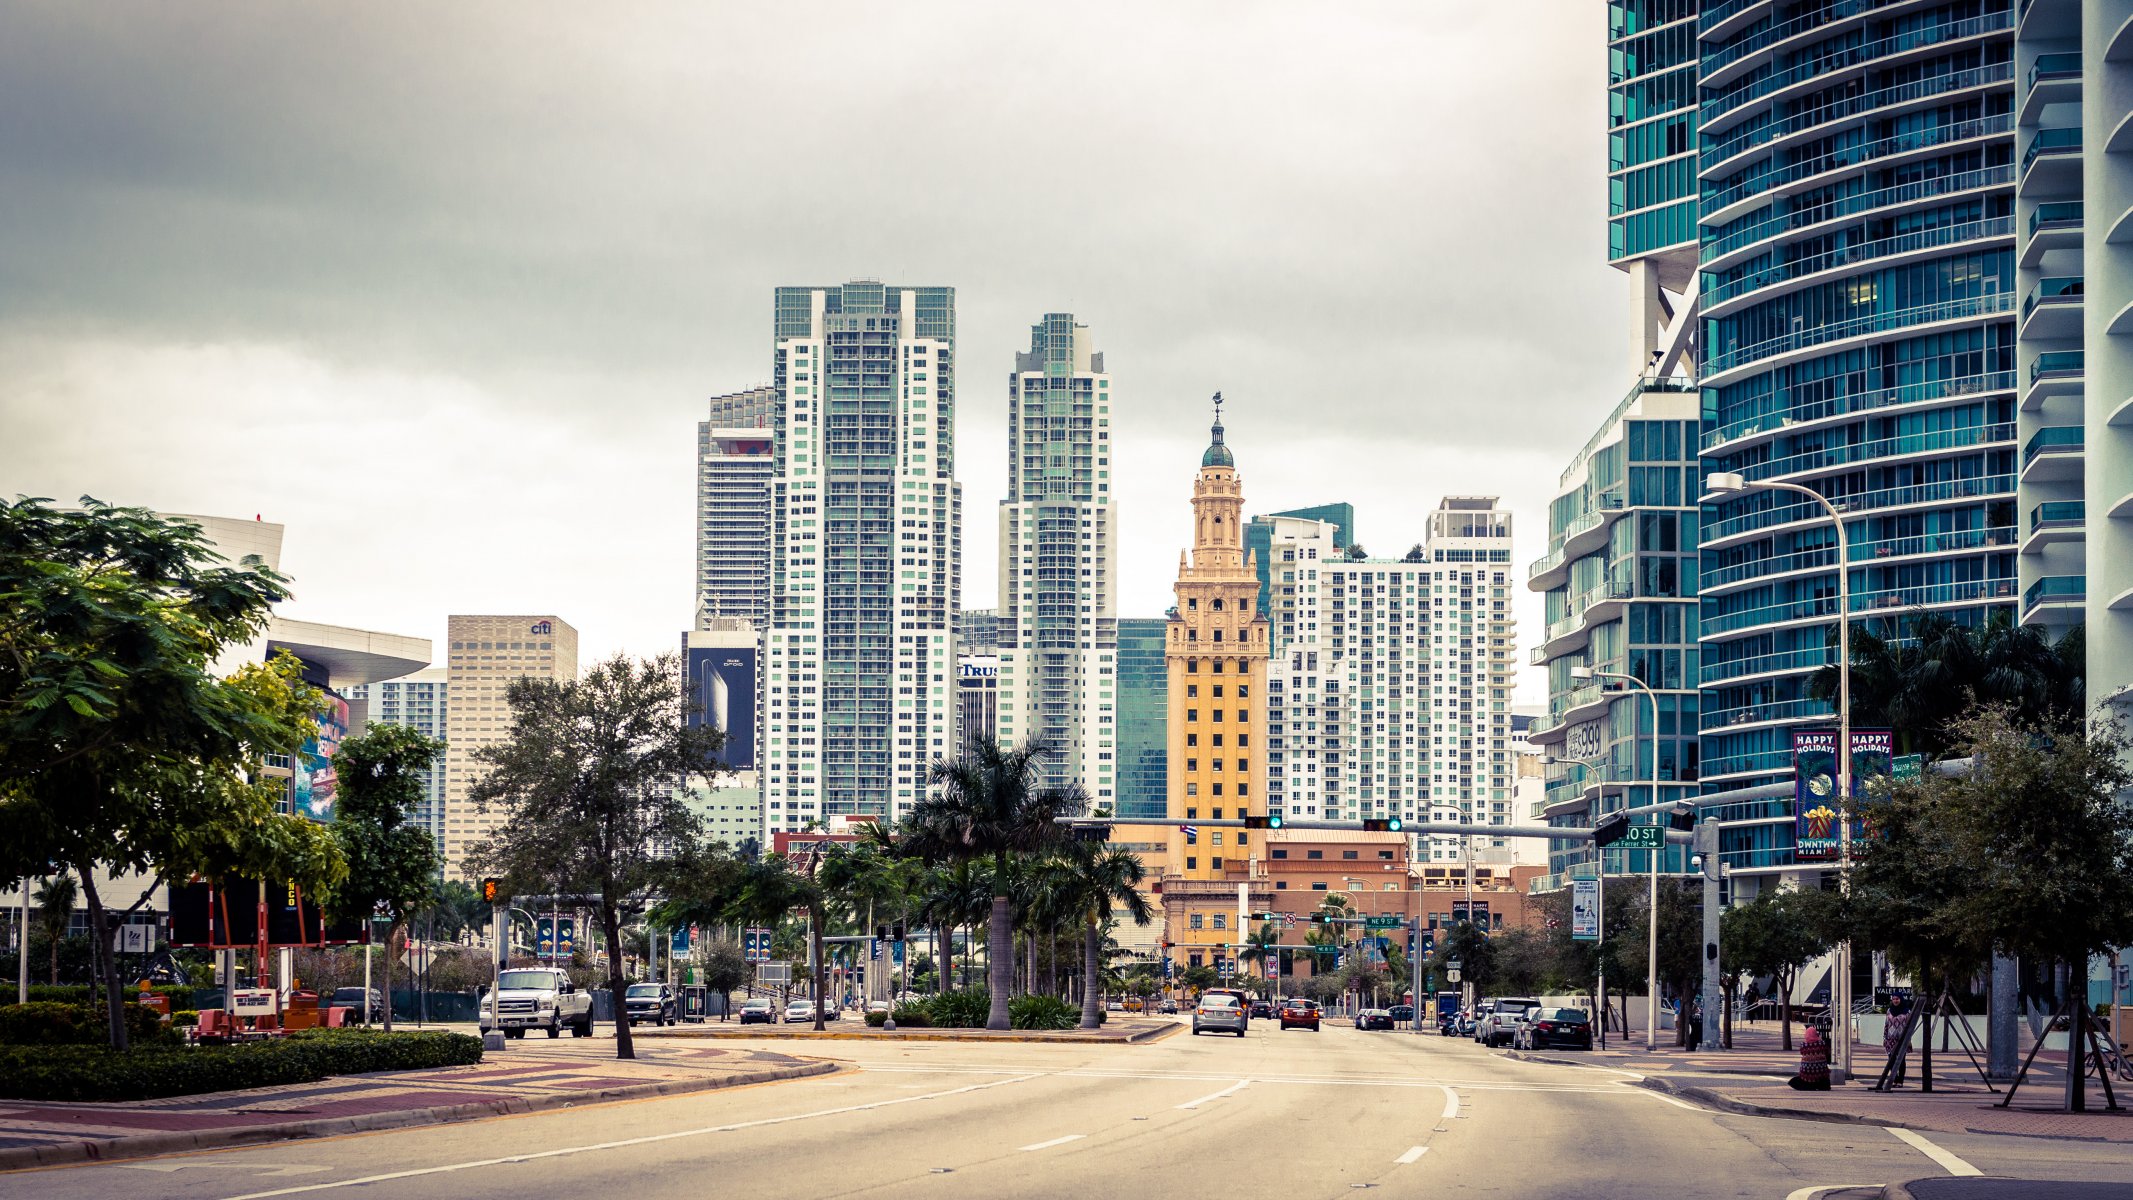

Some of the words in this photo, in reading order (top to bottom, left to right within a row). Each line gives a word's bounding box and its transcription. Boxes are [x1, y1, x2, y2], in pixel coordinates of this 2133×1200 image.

[531, 621, 551, 635] citi
[1797, 735, 1833, 744] HAPPY
[1852, 735, 1888, 744] HAPPY
[1797, 745, 1836, 754] HOLIDAYS
[1851, 745, 1891, 754] HOLIDAYS
[1642, 828, 1656, 839] ST
[1798, 840, 1837, 848] DWNTWN
